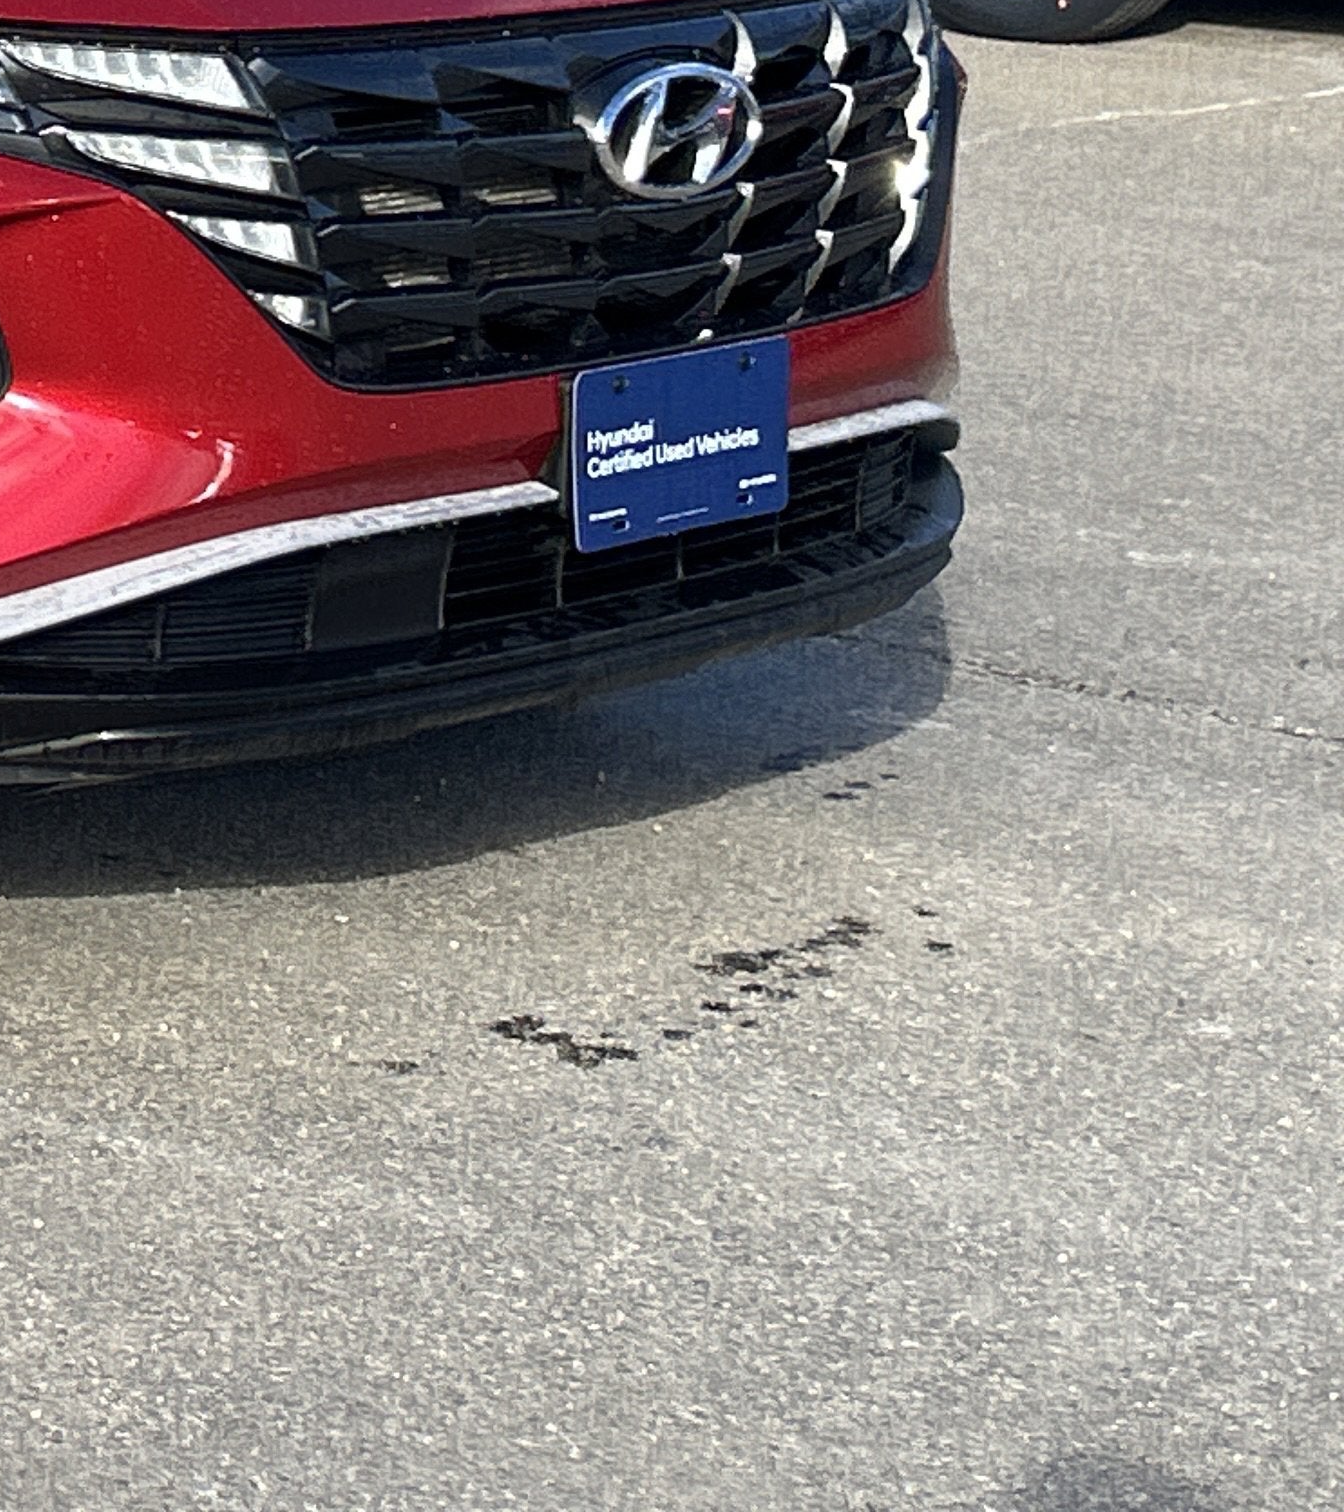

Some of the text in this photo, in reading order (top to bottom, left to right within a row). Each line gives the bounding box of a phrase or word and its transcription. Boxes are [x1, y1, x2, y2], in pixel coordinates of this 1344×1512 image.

[587, 419, 654, 454] Hyundai
[587, 427, 759, 479] Certified Used Vehicles
